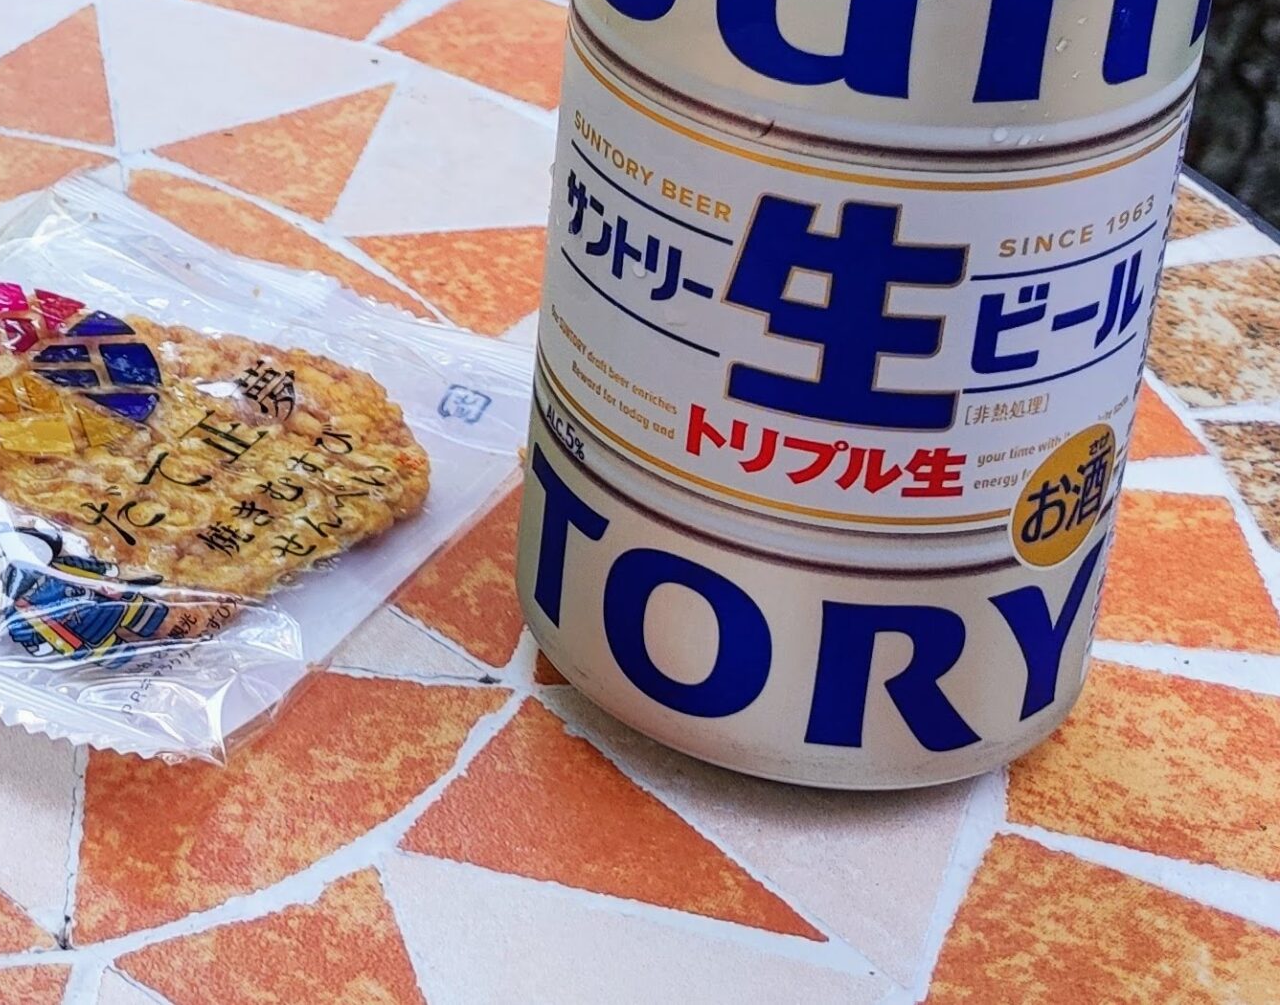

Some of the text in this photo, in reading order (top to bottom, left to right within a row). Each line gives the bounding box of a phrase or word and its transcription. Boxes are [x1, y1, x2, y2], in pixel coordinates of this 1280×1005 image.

[574, 109, 732, 223] SUNTORY BEER
[998, 194, 1154, 258] SINCE 1963
[567, 168, 714, 301] サントリー
[721, 193, 970, 433] 生
[971, 249, 1144, 374] ビール
[603, 387, 617, 406] for
[619, 400, 649, 430] today
[652, 422, 676, 440] and
[631, 384, 678, 415] enriches
[80, 359, 297, 546] だて正夢
[197, 424, 354, 558] 焼きむすび
[686, 403, 966, 498] トリプル生
[974, 472, 1018, 490] energy
[977, 448, 1005, 467] your
[1009, 444, 1036, 459] time
[1038, 435, 1062, 451] with
[1021, 445, 1112, 543] お酒
[271, 465, 392, 558] せんべい
[531, 441, 1108, 752] TORY
